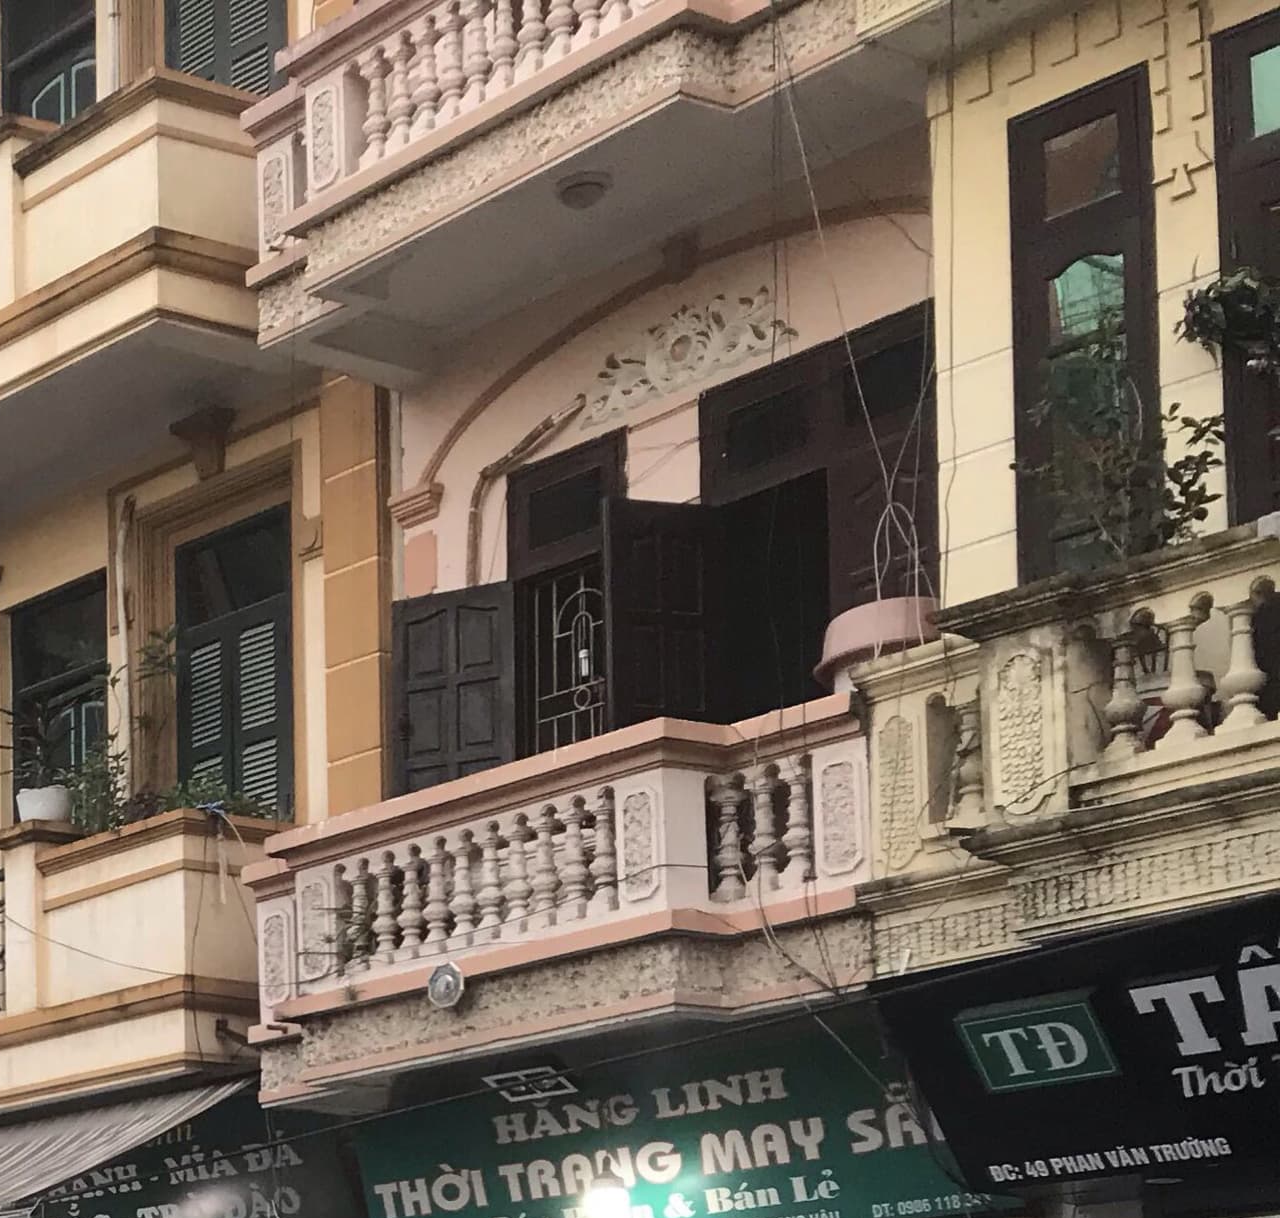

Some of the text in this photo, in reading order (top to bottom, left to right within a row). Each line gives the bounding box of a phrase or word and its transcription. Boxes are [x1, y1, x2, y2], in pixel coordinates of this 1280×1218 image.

[982, 1022, 1089, 1077] TĐ
[651, 1067, 789, 1119] LINH
[1171, 1056, 1265, 1099] Thời
[498, 1141, 682, 1203] TRANG
[700, 1117, 825, 1176] MAY
[1025, 1158, 1050, 1179] 49
[1050, 1152, 1105, 1175] PHAN
[1104, 1145, 1150, 1168] VĂN
[1149, 1136, 1232, 1163] TRƯỜNG
[704, 1183, 781, 1216] Bán
[790, 1168, 841, 1203] Lẻ
